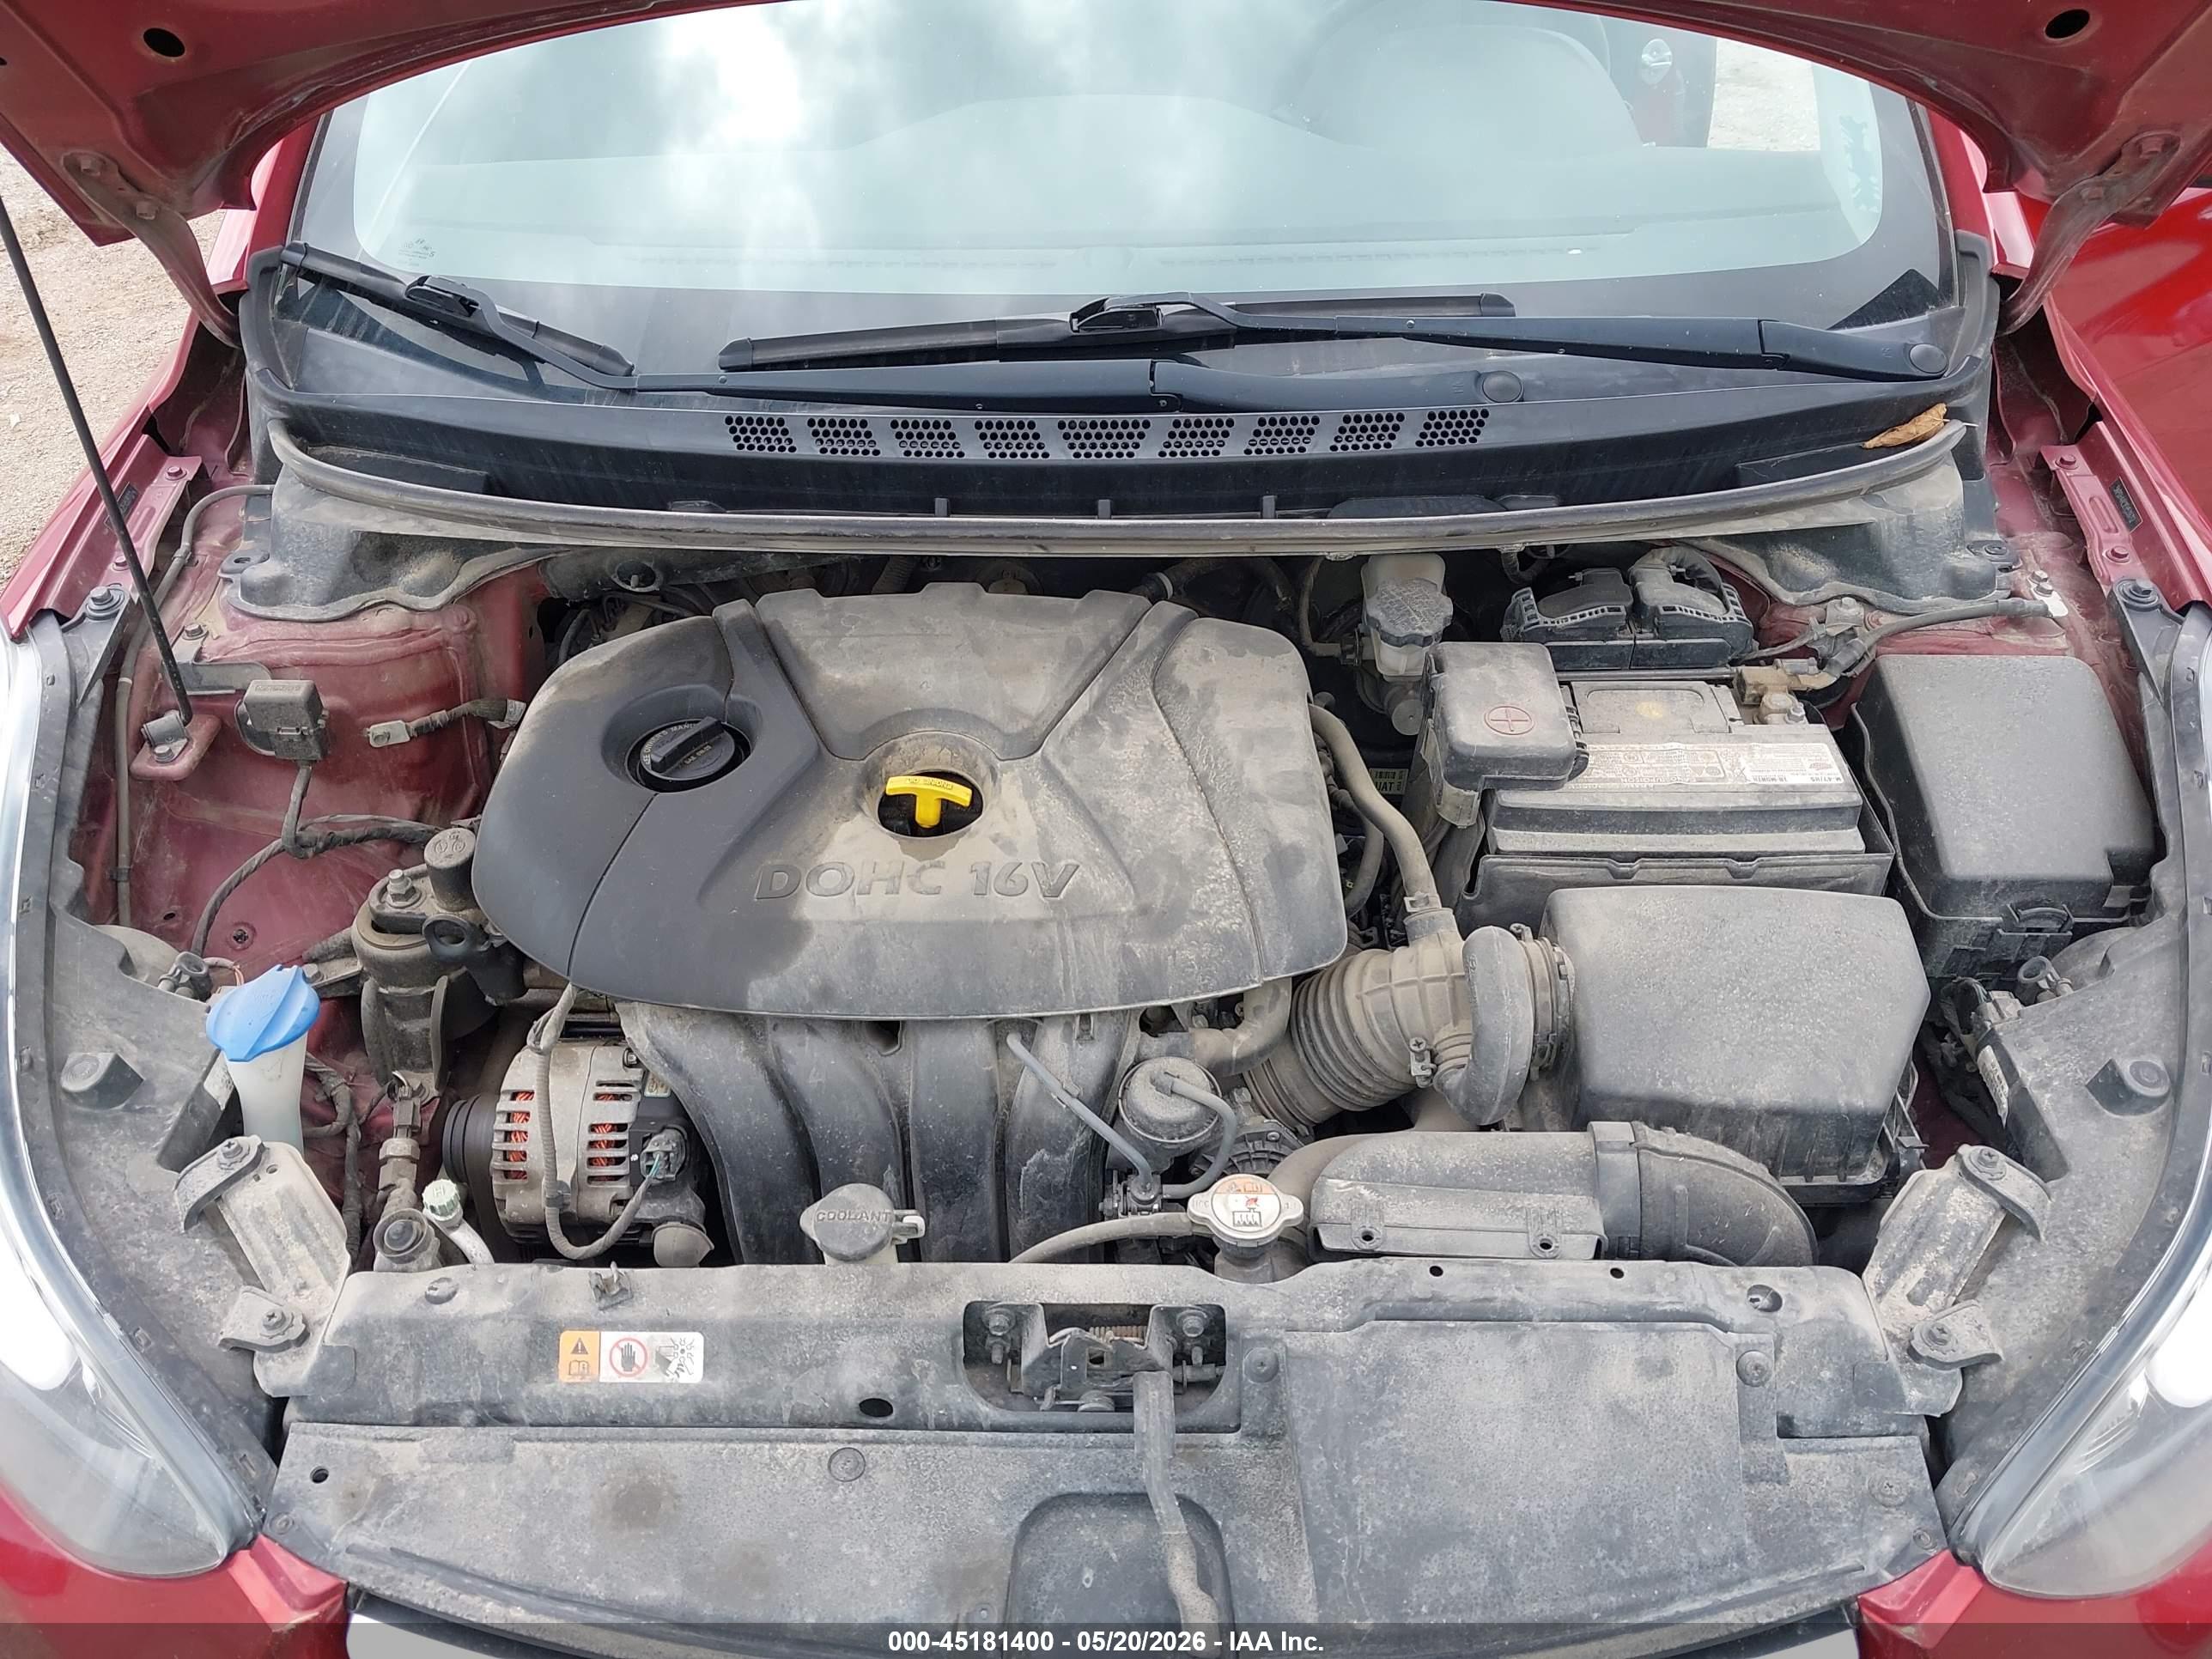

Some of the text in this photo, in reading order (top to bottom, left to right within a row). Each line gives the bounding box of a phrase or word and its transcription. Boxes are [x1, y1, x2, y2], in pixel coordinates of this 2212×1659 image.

[754, 860, 1080, 901] DOHC 16V
[816, 1209, 891, 1223] COOLANT
